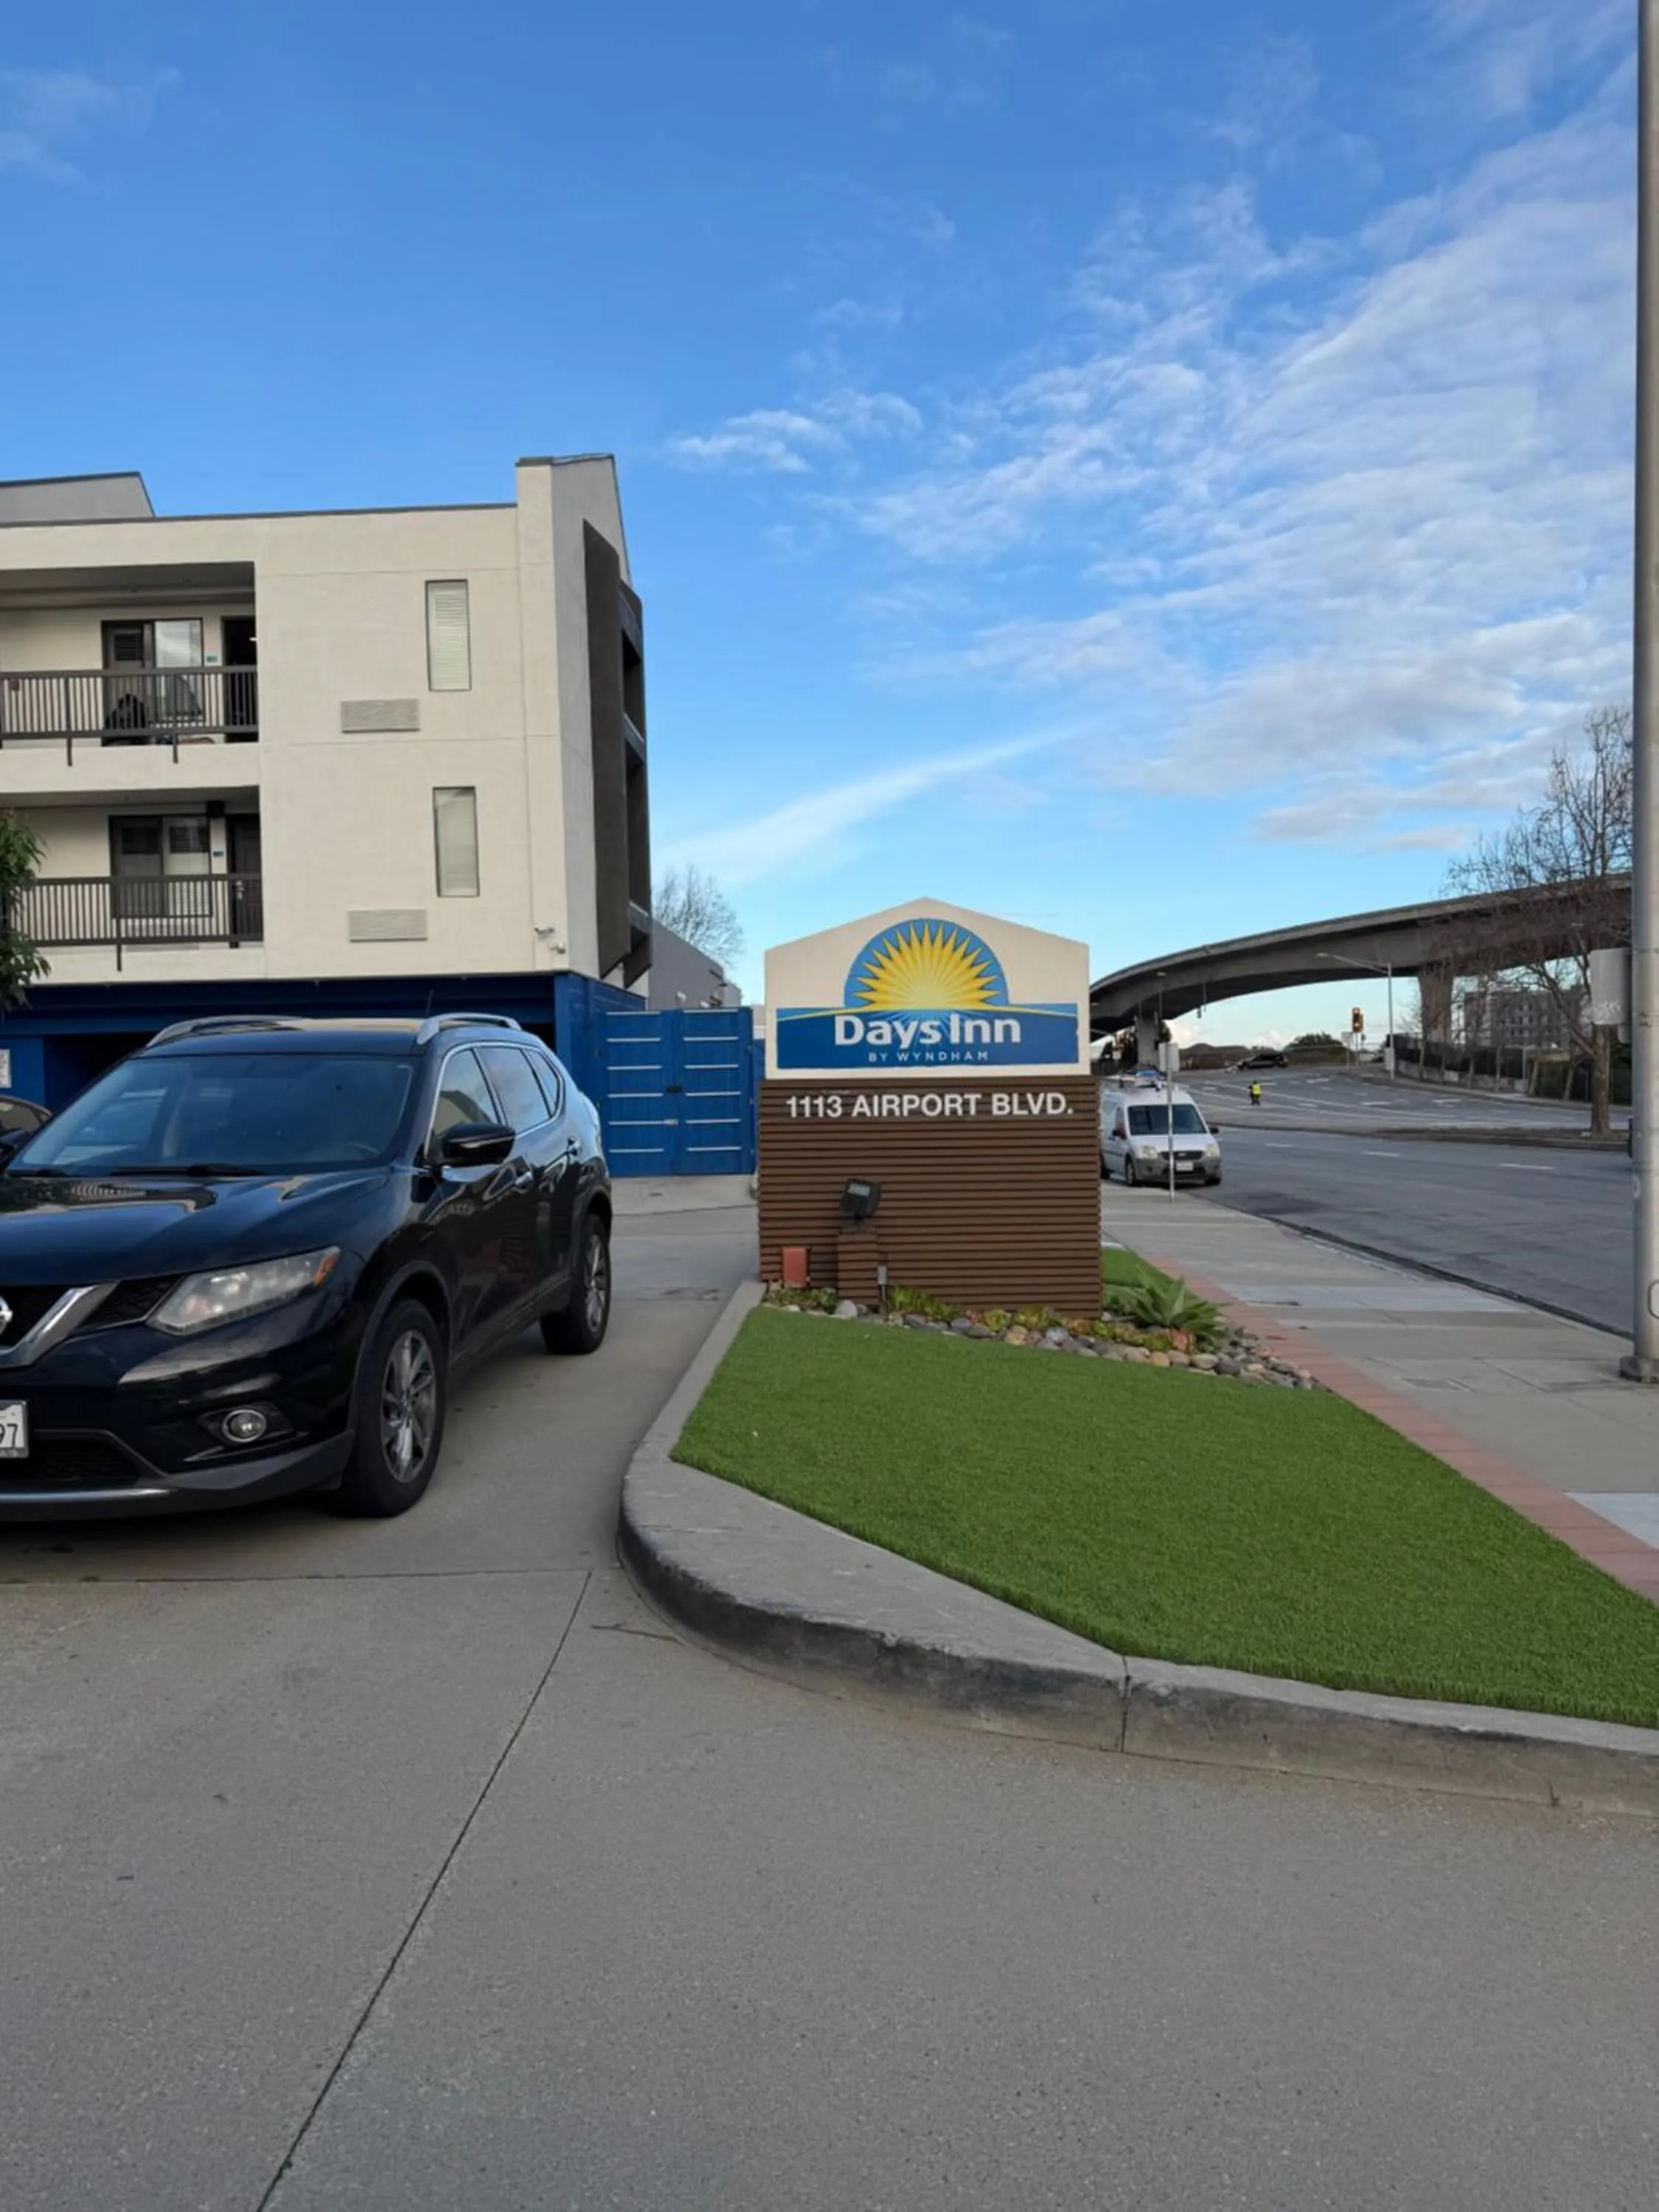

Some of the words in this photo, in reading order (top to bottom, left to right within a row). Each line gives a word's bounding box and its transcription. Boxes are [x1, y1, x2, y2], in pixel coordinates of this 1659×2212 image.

[835, 1015, 942, 1049] Days
[950, 1014, 1021, 1043] Inn
[869, 1053, 887, 1062] BY
[897, 1051, 989, 1062] WYNDHAM
[786, 1096, 842, 1118] 1113
[852, 1093, 981, 1117] AIRPORT
[992, 1093, 1074, 1116] BLVD.
